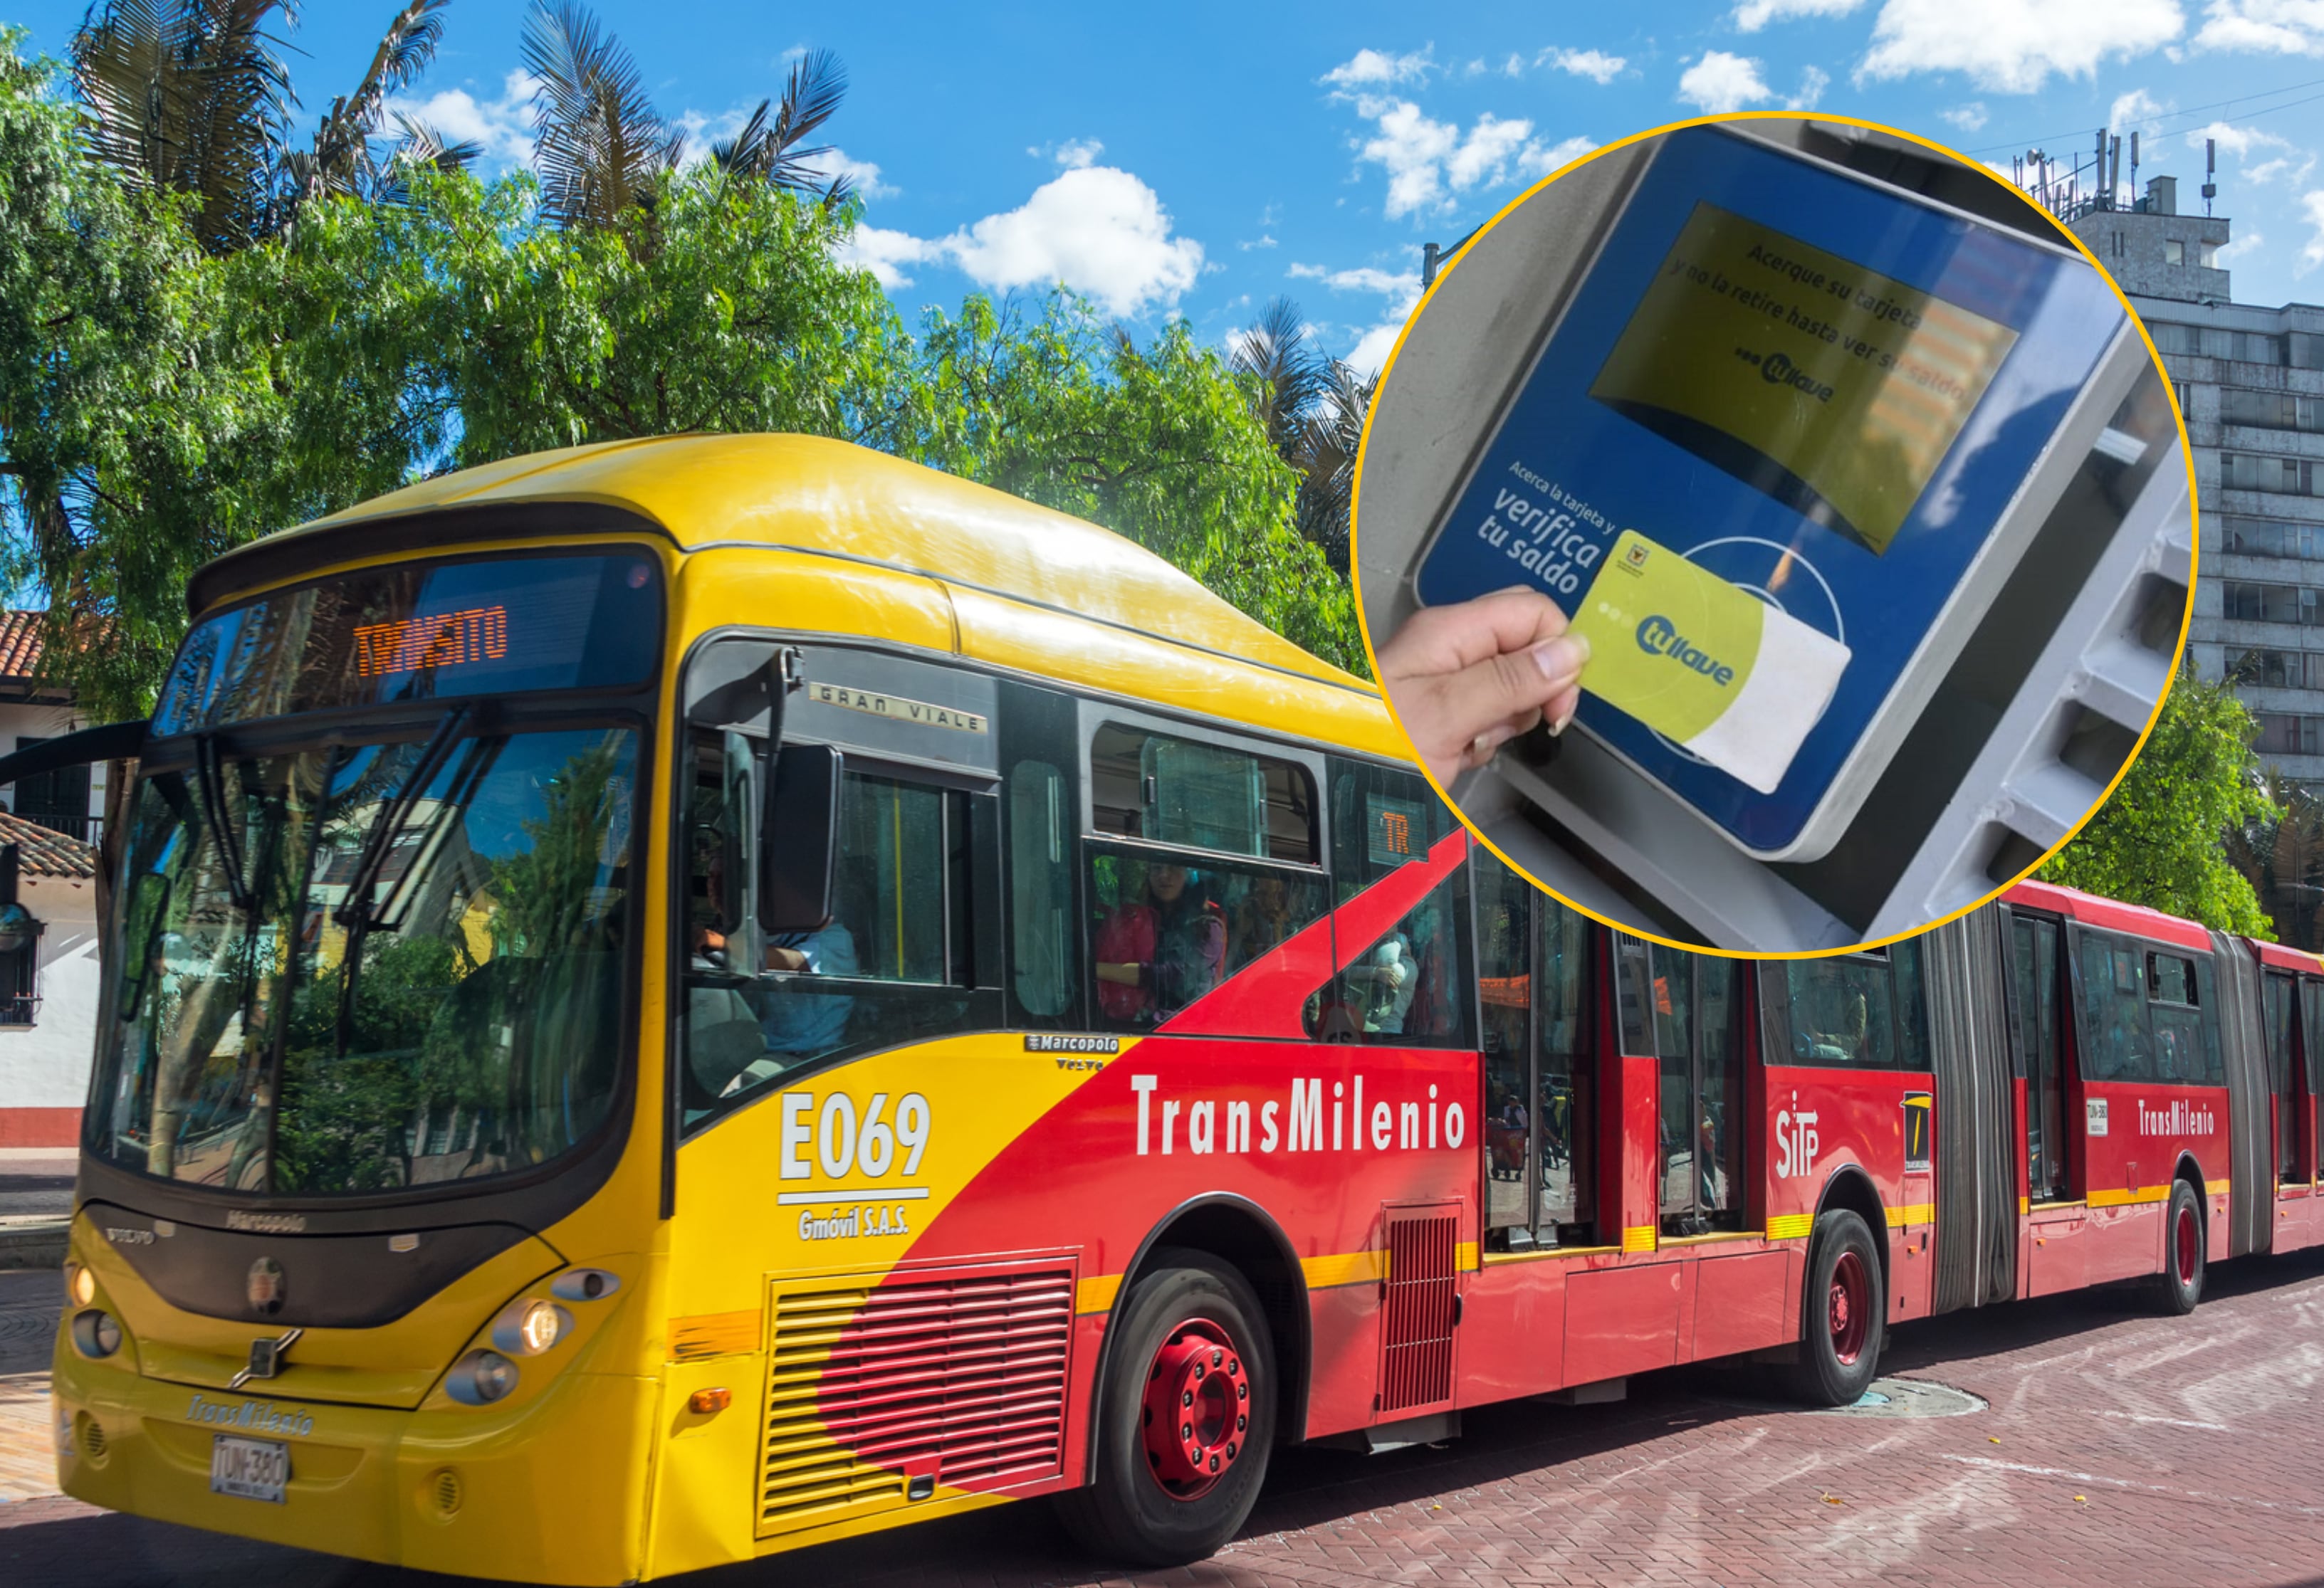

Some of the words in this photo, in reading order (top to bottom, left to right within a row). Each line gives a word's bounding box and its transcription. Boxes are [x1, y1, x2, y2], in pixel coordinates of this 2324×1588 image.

[1670, 259, 1685, 275] y
[1687, 265, 1708, 284] no
[1712, 273, 1729, 294] la
[1731, 286, 1784, 318] retire
[1786, 306, 1838, 343] hasta
[1844, 336, 1878, 359] ver
[1747, 245, 1825, 288] Acerque
[1827, 280, 1852, 300] su
[1855, 290, 1922, 330] tarjeta
[1494, 488, 1601, 568] verifica
[1509, 461, 1549, 493] Acerca
[1549, 484, 1562, 500] la
[1563, 493, 1605, 527] tarjeta
[1603, 522, 1616, 535] y
[1478, 515, 1509, 547] tu
[1506, 540, 1579, 594] saldo
[353, 606, 508, 676] TRANSITO
[909, 705, 978, 729] VIALE
[1041, 1036, 1118, 1051] Marcopolo
[780, 1092, 931, 1179] E069
[1131, 1075, 1465, 1155] TransMilenio
[2138, 1099, 2214, 1135] TransMilenio
[226, 1210, 306, 1232] Marcopolo
[799, 1209, 859, 1241] Gmóvil
[863, 1206, 909, 1236] S.A.S.
[187, 1394, 314, 1436] TransMilenio
